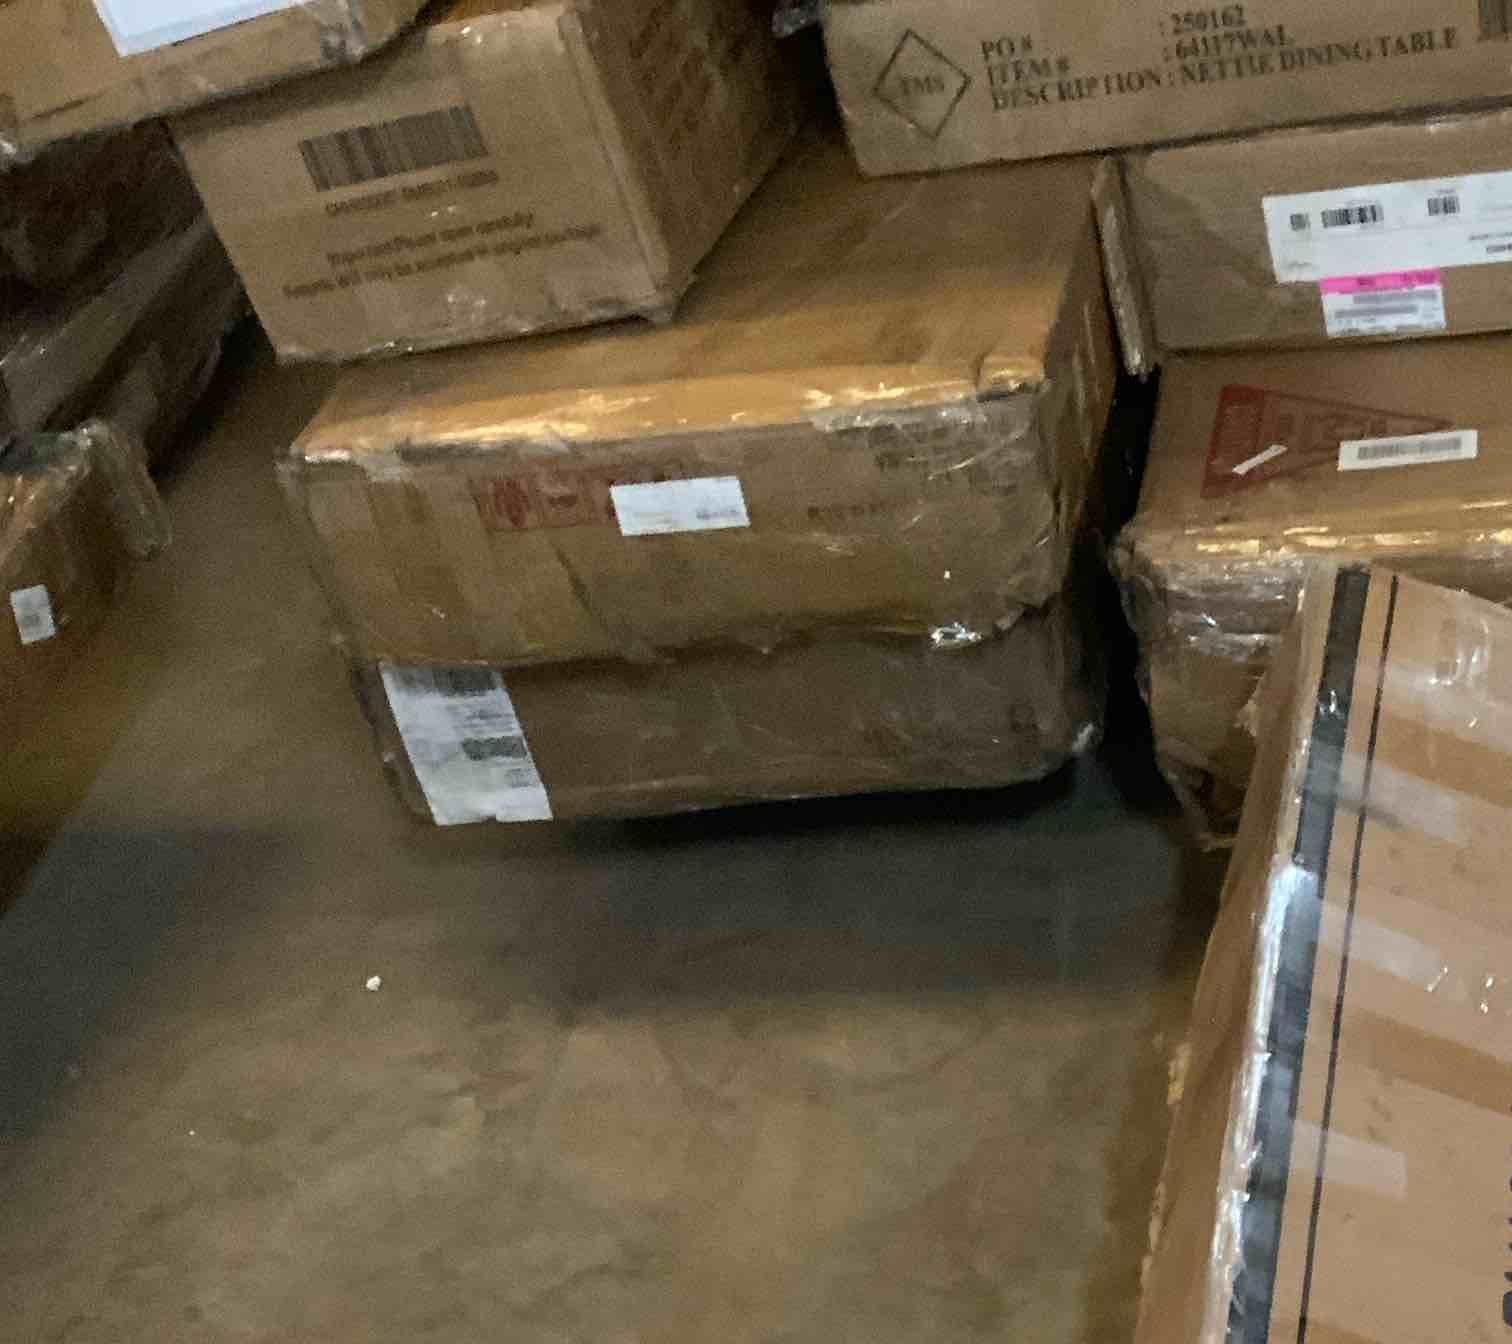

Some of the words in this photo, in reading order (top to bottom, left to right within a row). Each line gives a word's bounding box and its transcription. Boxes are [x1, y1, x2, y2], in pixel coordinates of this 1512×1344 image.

[979, 36, 1015, 60] PO
[986, 57, 1052, 85] ITEM
[990, 69, 1163, 111] DESCRIPTION
[1179, 53, 1275, 85] NETTLE
[1279, 41, 1372, 74] DINING
[1376, 26, 1457, 58] TABLE
